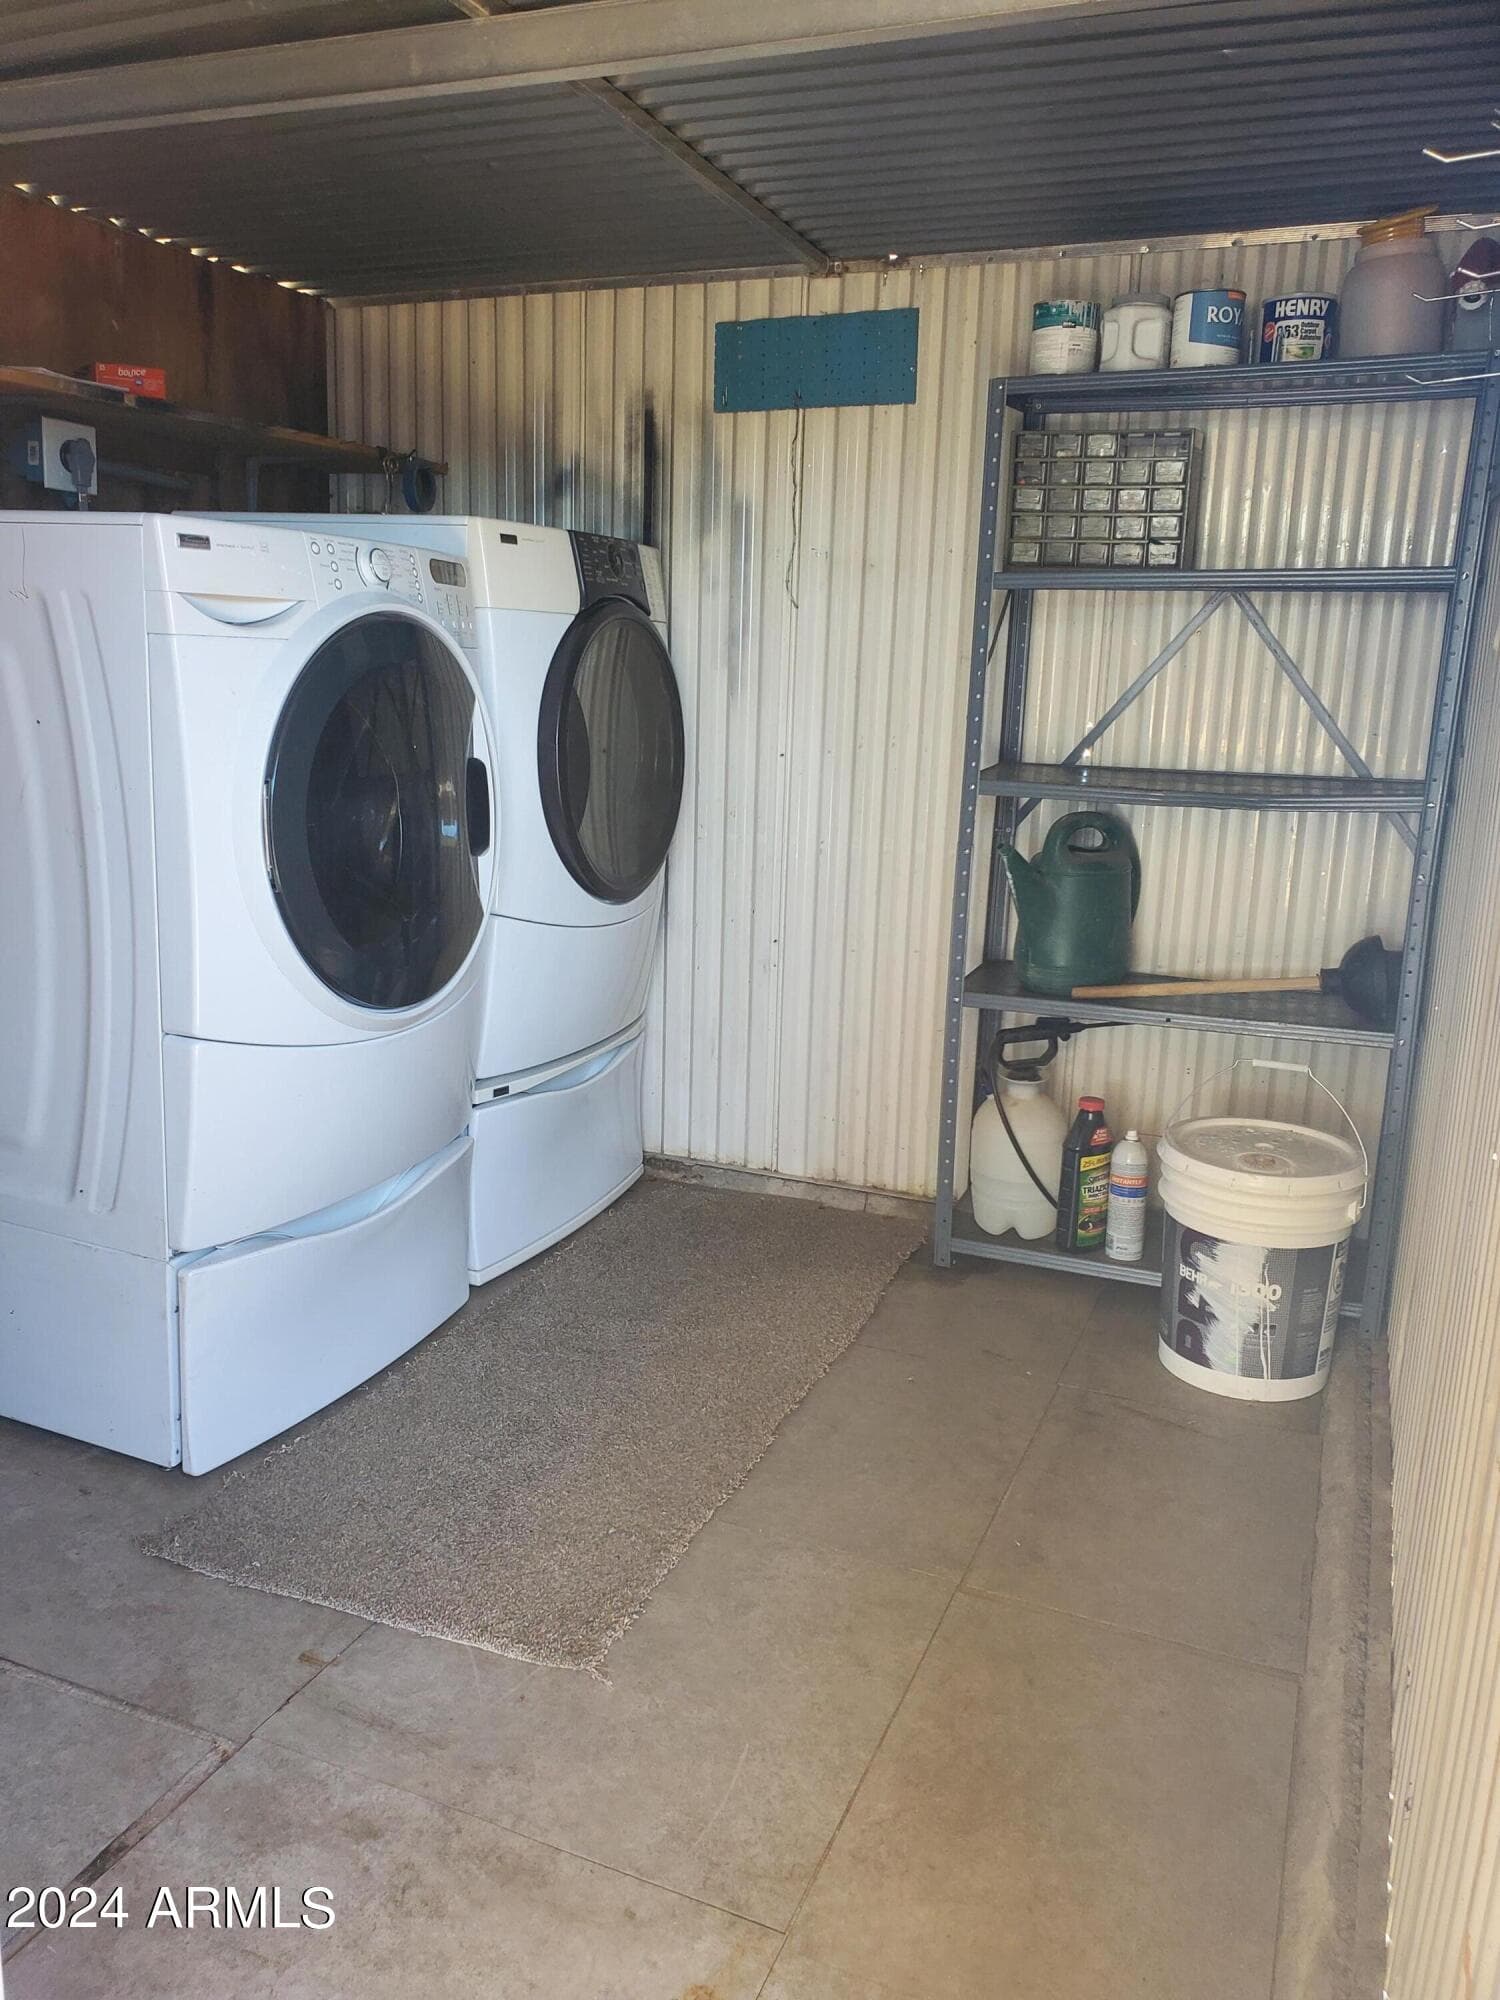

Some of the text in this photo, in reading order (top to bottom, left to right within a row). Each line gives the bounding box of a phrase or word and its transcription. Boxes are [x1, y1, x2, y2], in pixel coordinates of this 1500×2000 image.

[1206, 305, 1243, 326] ROY
[1275, 299, 1329, 318] HENRY
[118, 368, 146, 377] bounce
[1179, 1263, 1208, 1286] BEHR
